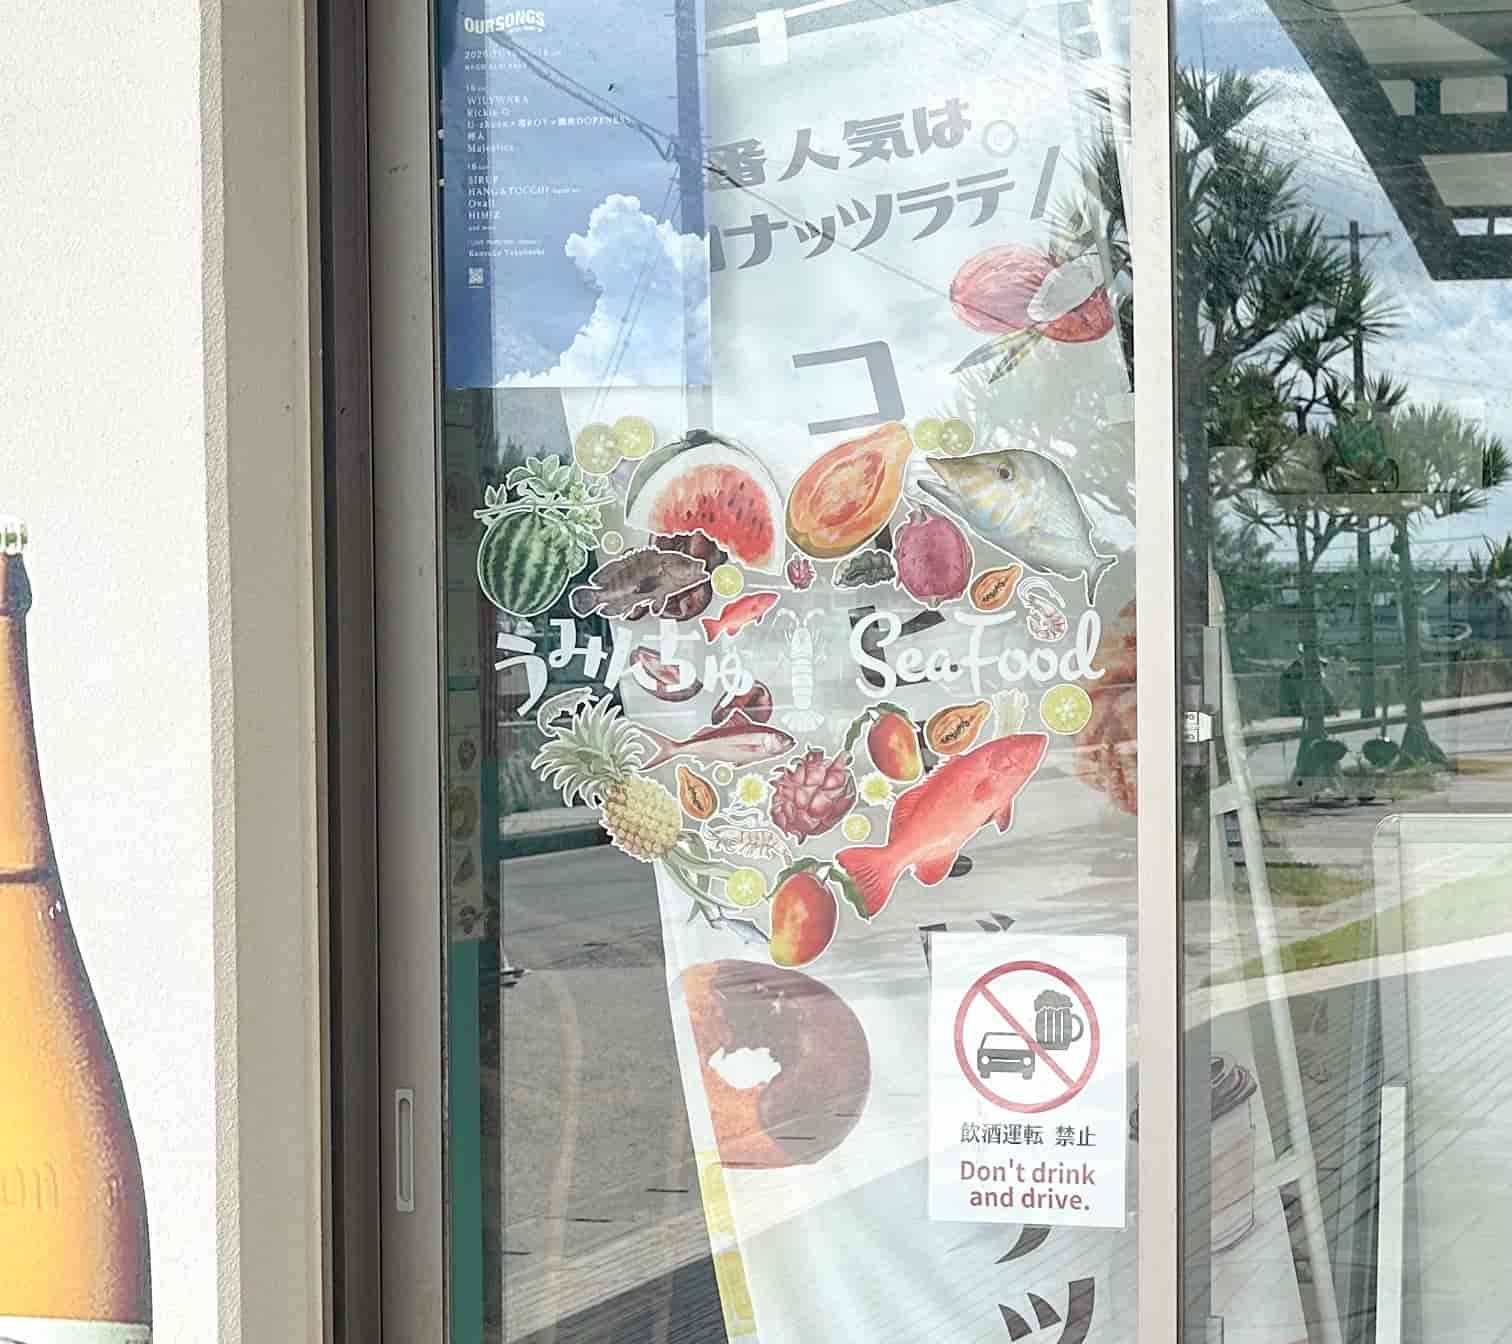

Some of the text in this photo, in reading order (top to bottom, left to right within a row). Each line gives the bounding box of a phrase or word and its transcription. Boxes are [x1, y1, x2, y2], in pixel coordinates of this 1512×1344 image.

[704, 168, 1016, 273] ナッツラテ
[494, 618, 754, 717] うみんちゅ
[960, 1121, 1097, 1147] 飲酒運転 禁止
[960, 1158, 1096, 1185] Don't drink
[970, 1186, 1091, 1211] and drive.
